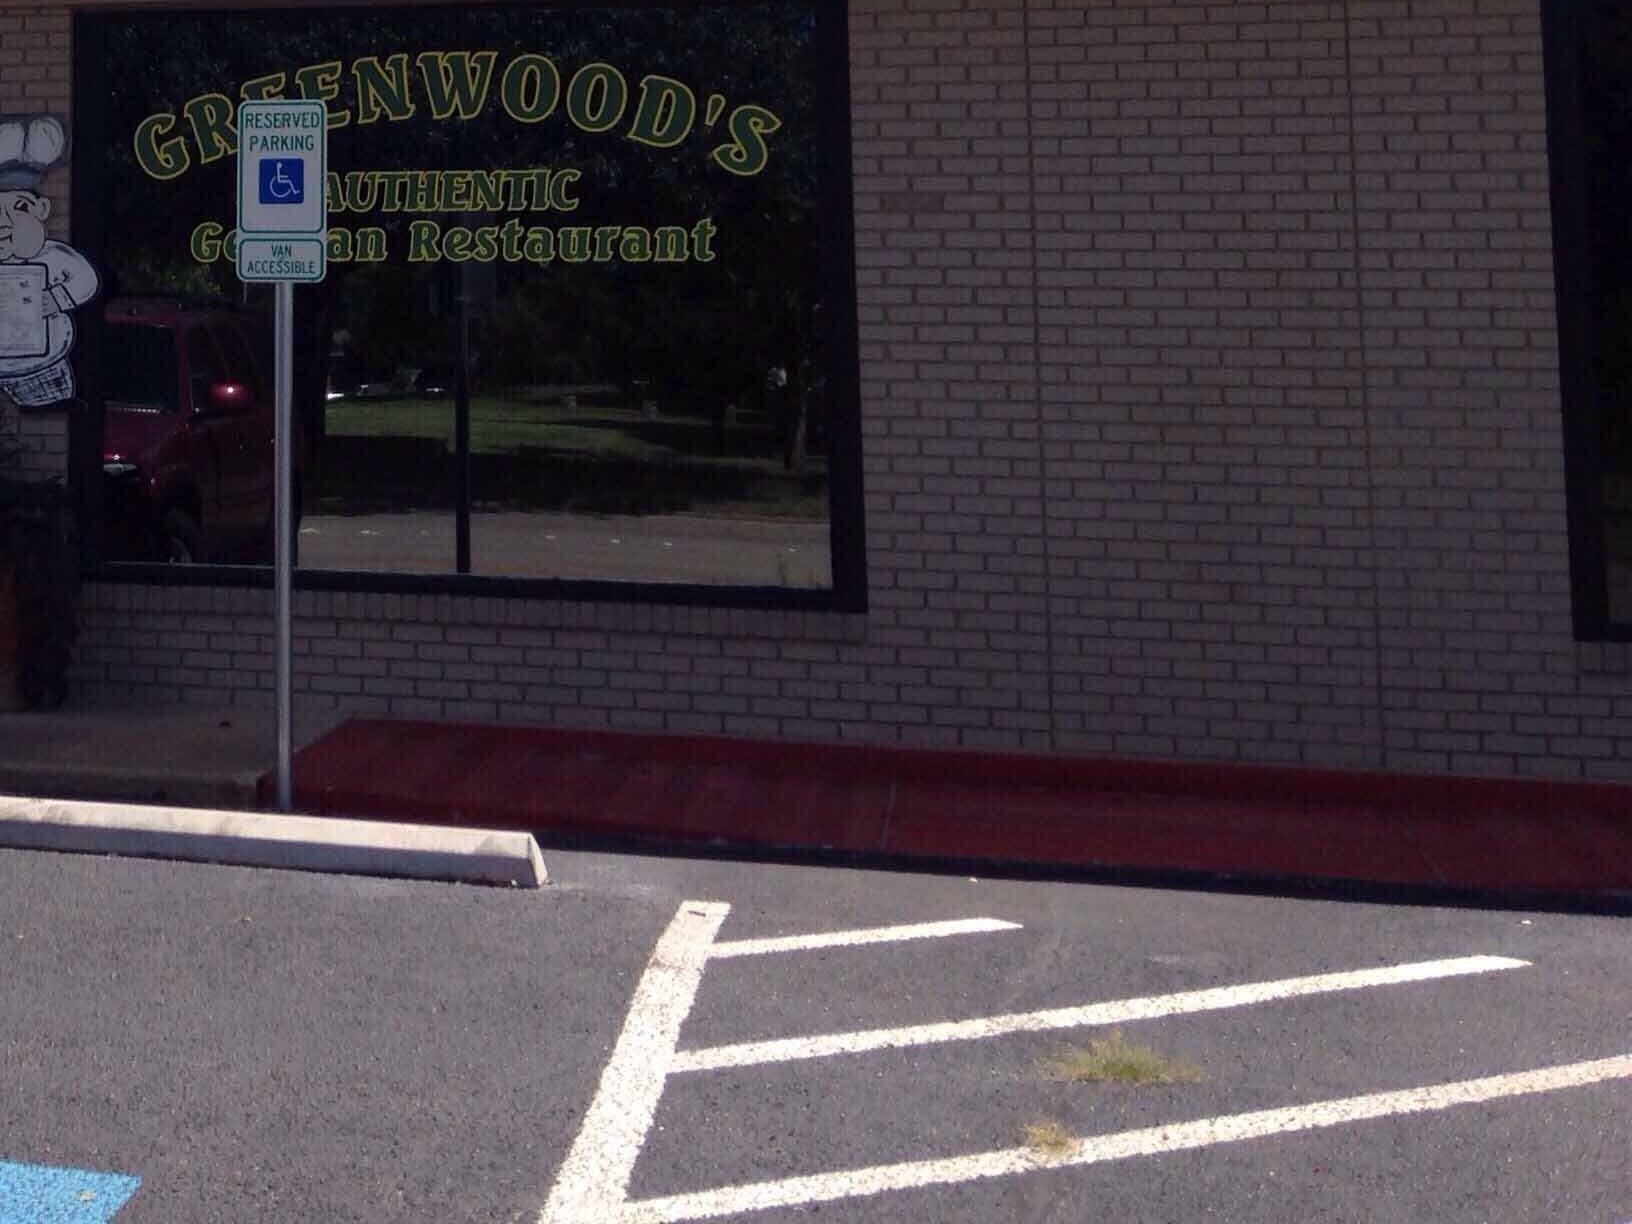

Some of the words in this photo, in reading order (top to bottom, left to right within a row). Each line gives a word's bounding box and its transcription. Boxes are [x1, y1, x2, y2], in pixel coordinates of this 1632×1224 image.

[245, 111, 320, 129] RESERVED
[249, 135, 314, 152] PARKING
[408, 218, 717, 262] Restaurant
[272, 244, 292, 257] VAN
[247, 261, 316, 274] ACCESSIBLE
